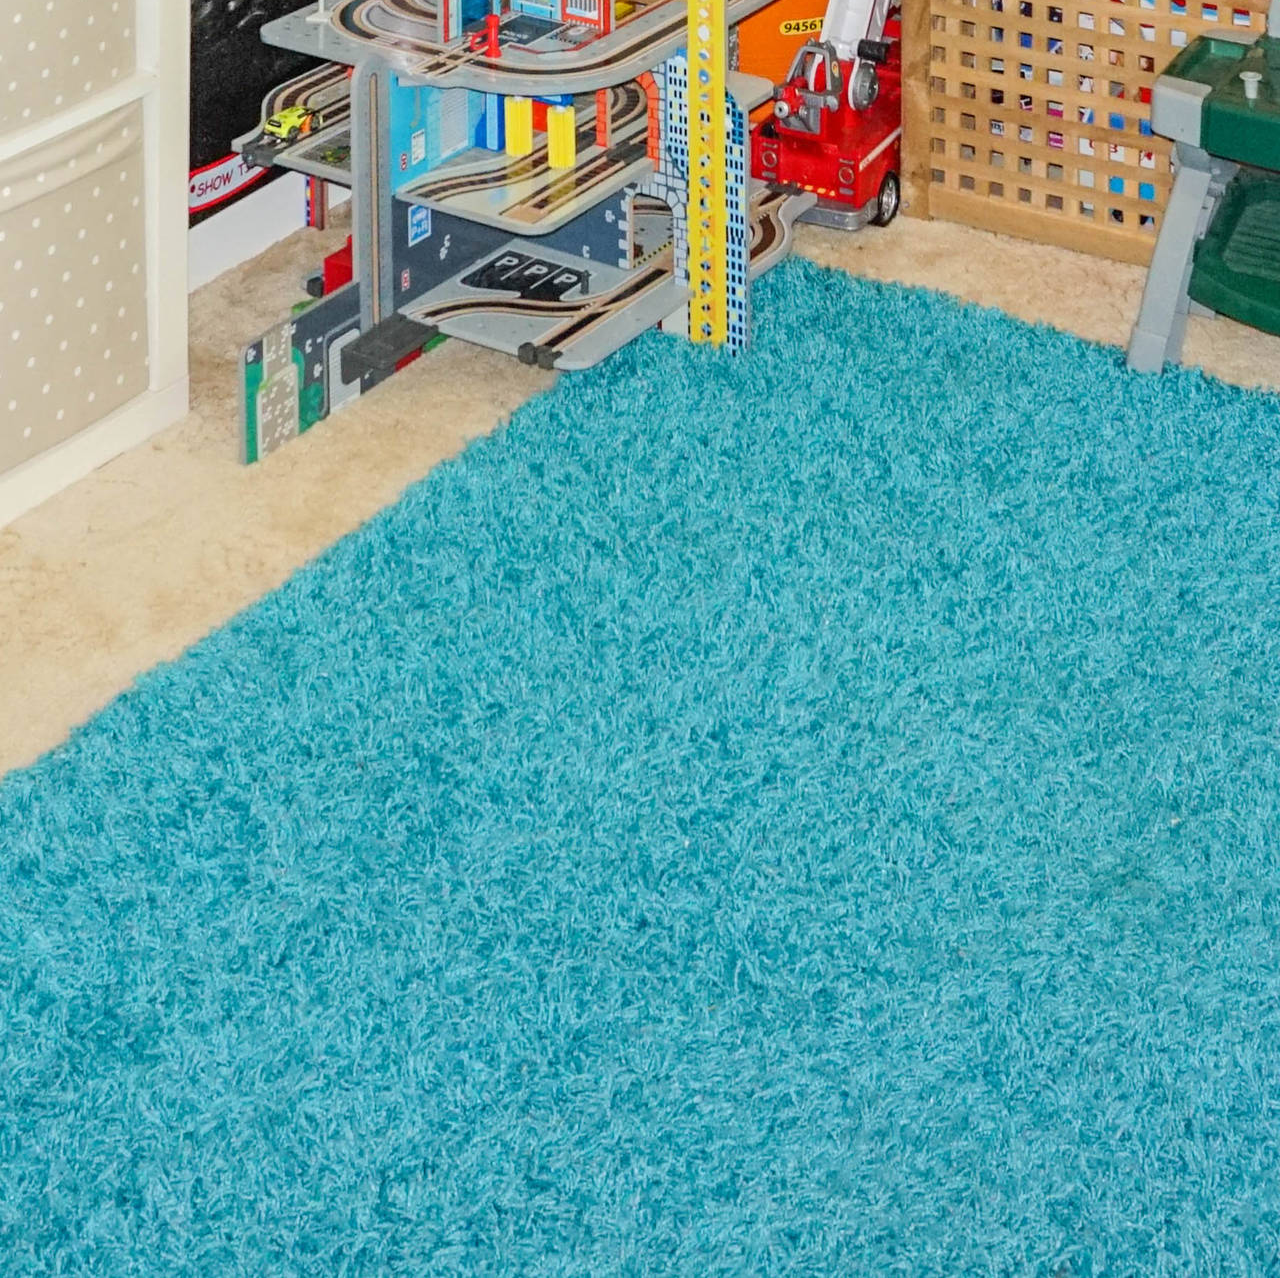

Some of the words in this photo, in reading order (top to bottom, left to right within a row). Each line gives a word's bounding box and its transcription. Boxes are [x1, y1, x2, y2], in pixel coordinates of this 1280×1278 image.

[196, 169, 233, 197] SHOW
[494, 256, 519, 267] P
[523, 264, 549, 275] P
[553, 273, 578, 284] P
